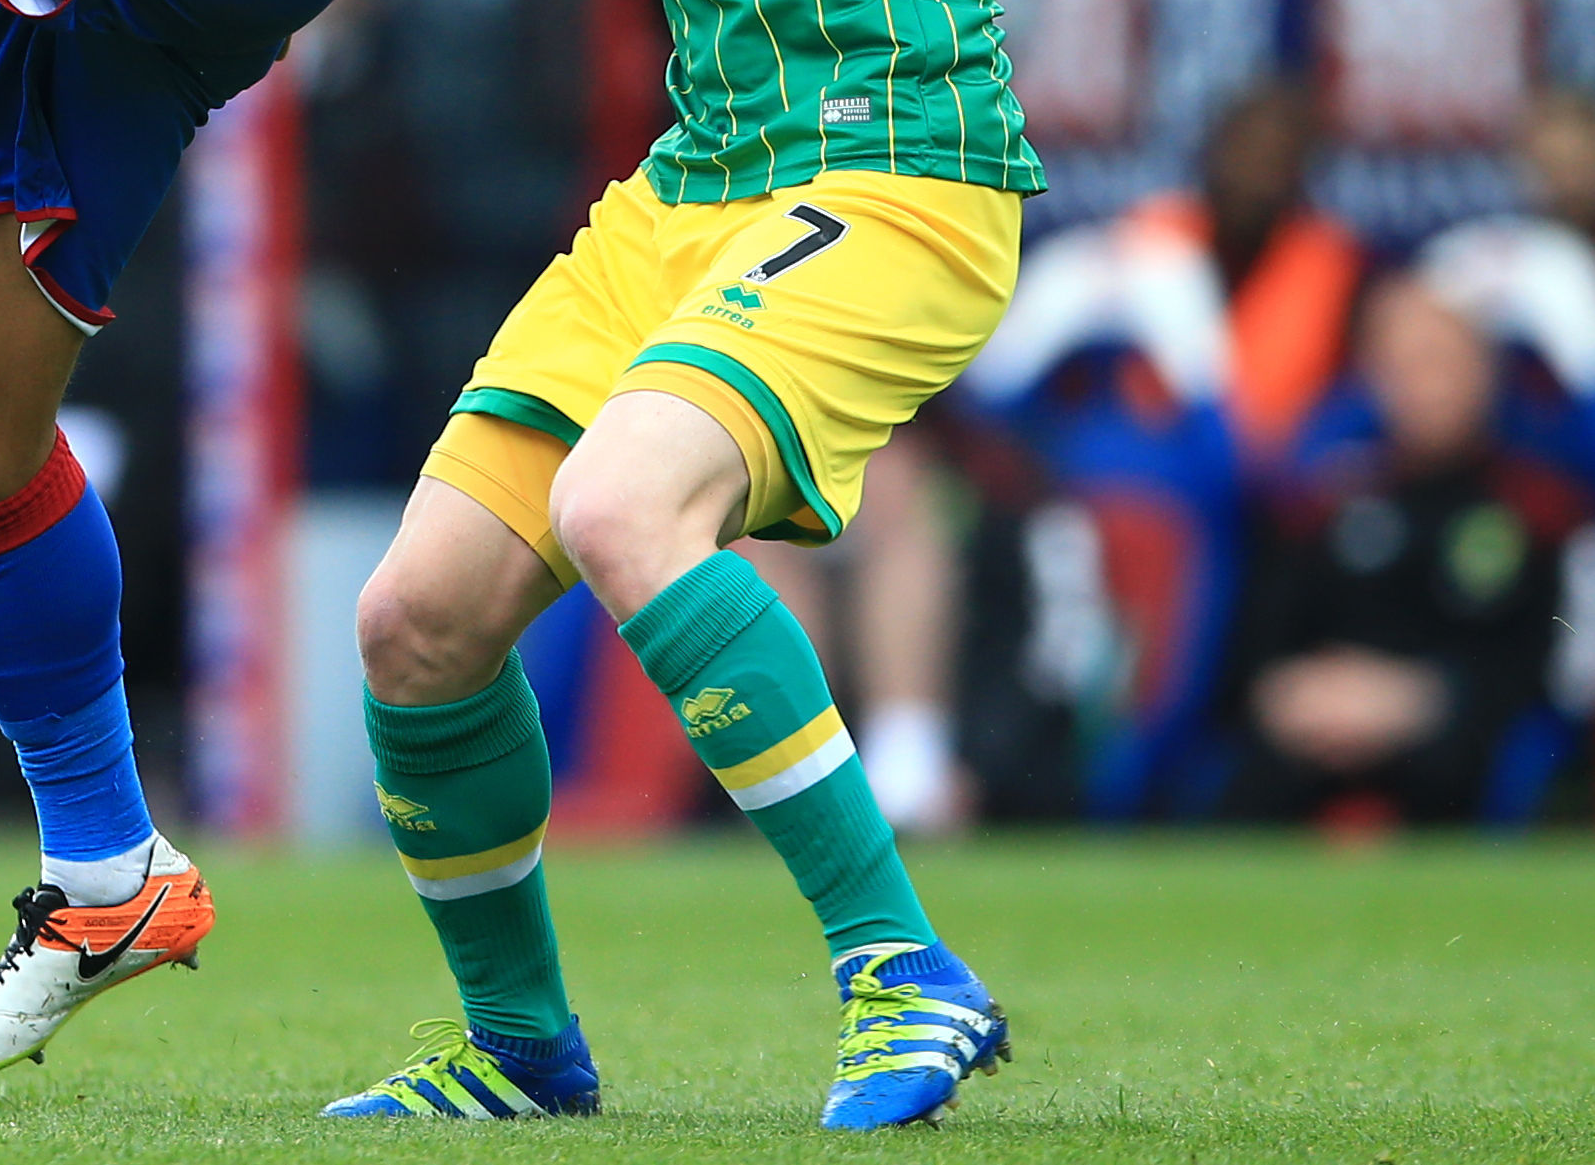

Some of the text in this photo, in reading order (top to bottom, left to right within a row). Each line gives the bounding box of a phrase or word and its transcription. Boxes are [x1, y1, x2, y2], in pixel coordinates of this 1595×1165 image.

[823, 97, 870, 108] AUTHENTIC
[740, 201, 852, 286] 7
[701, 304, 755, 330] errea
